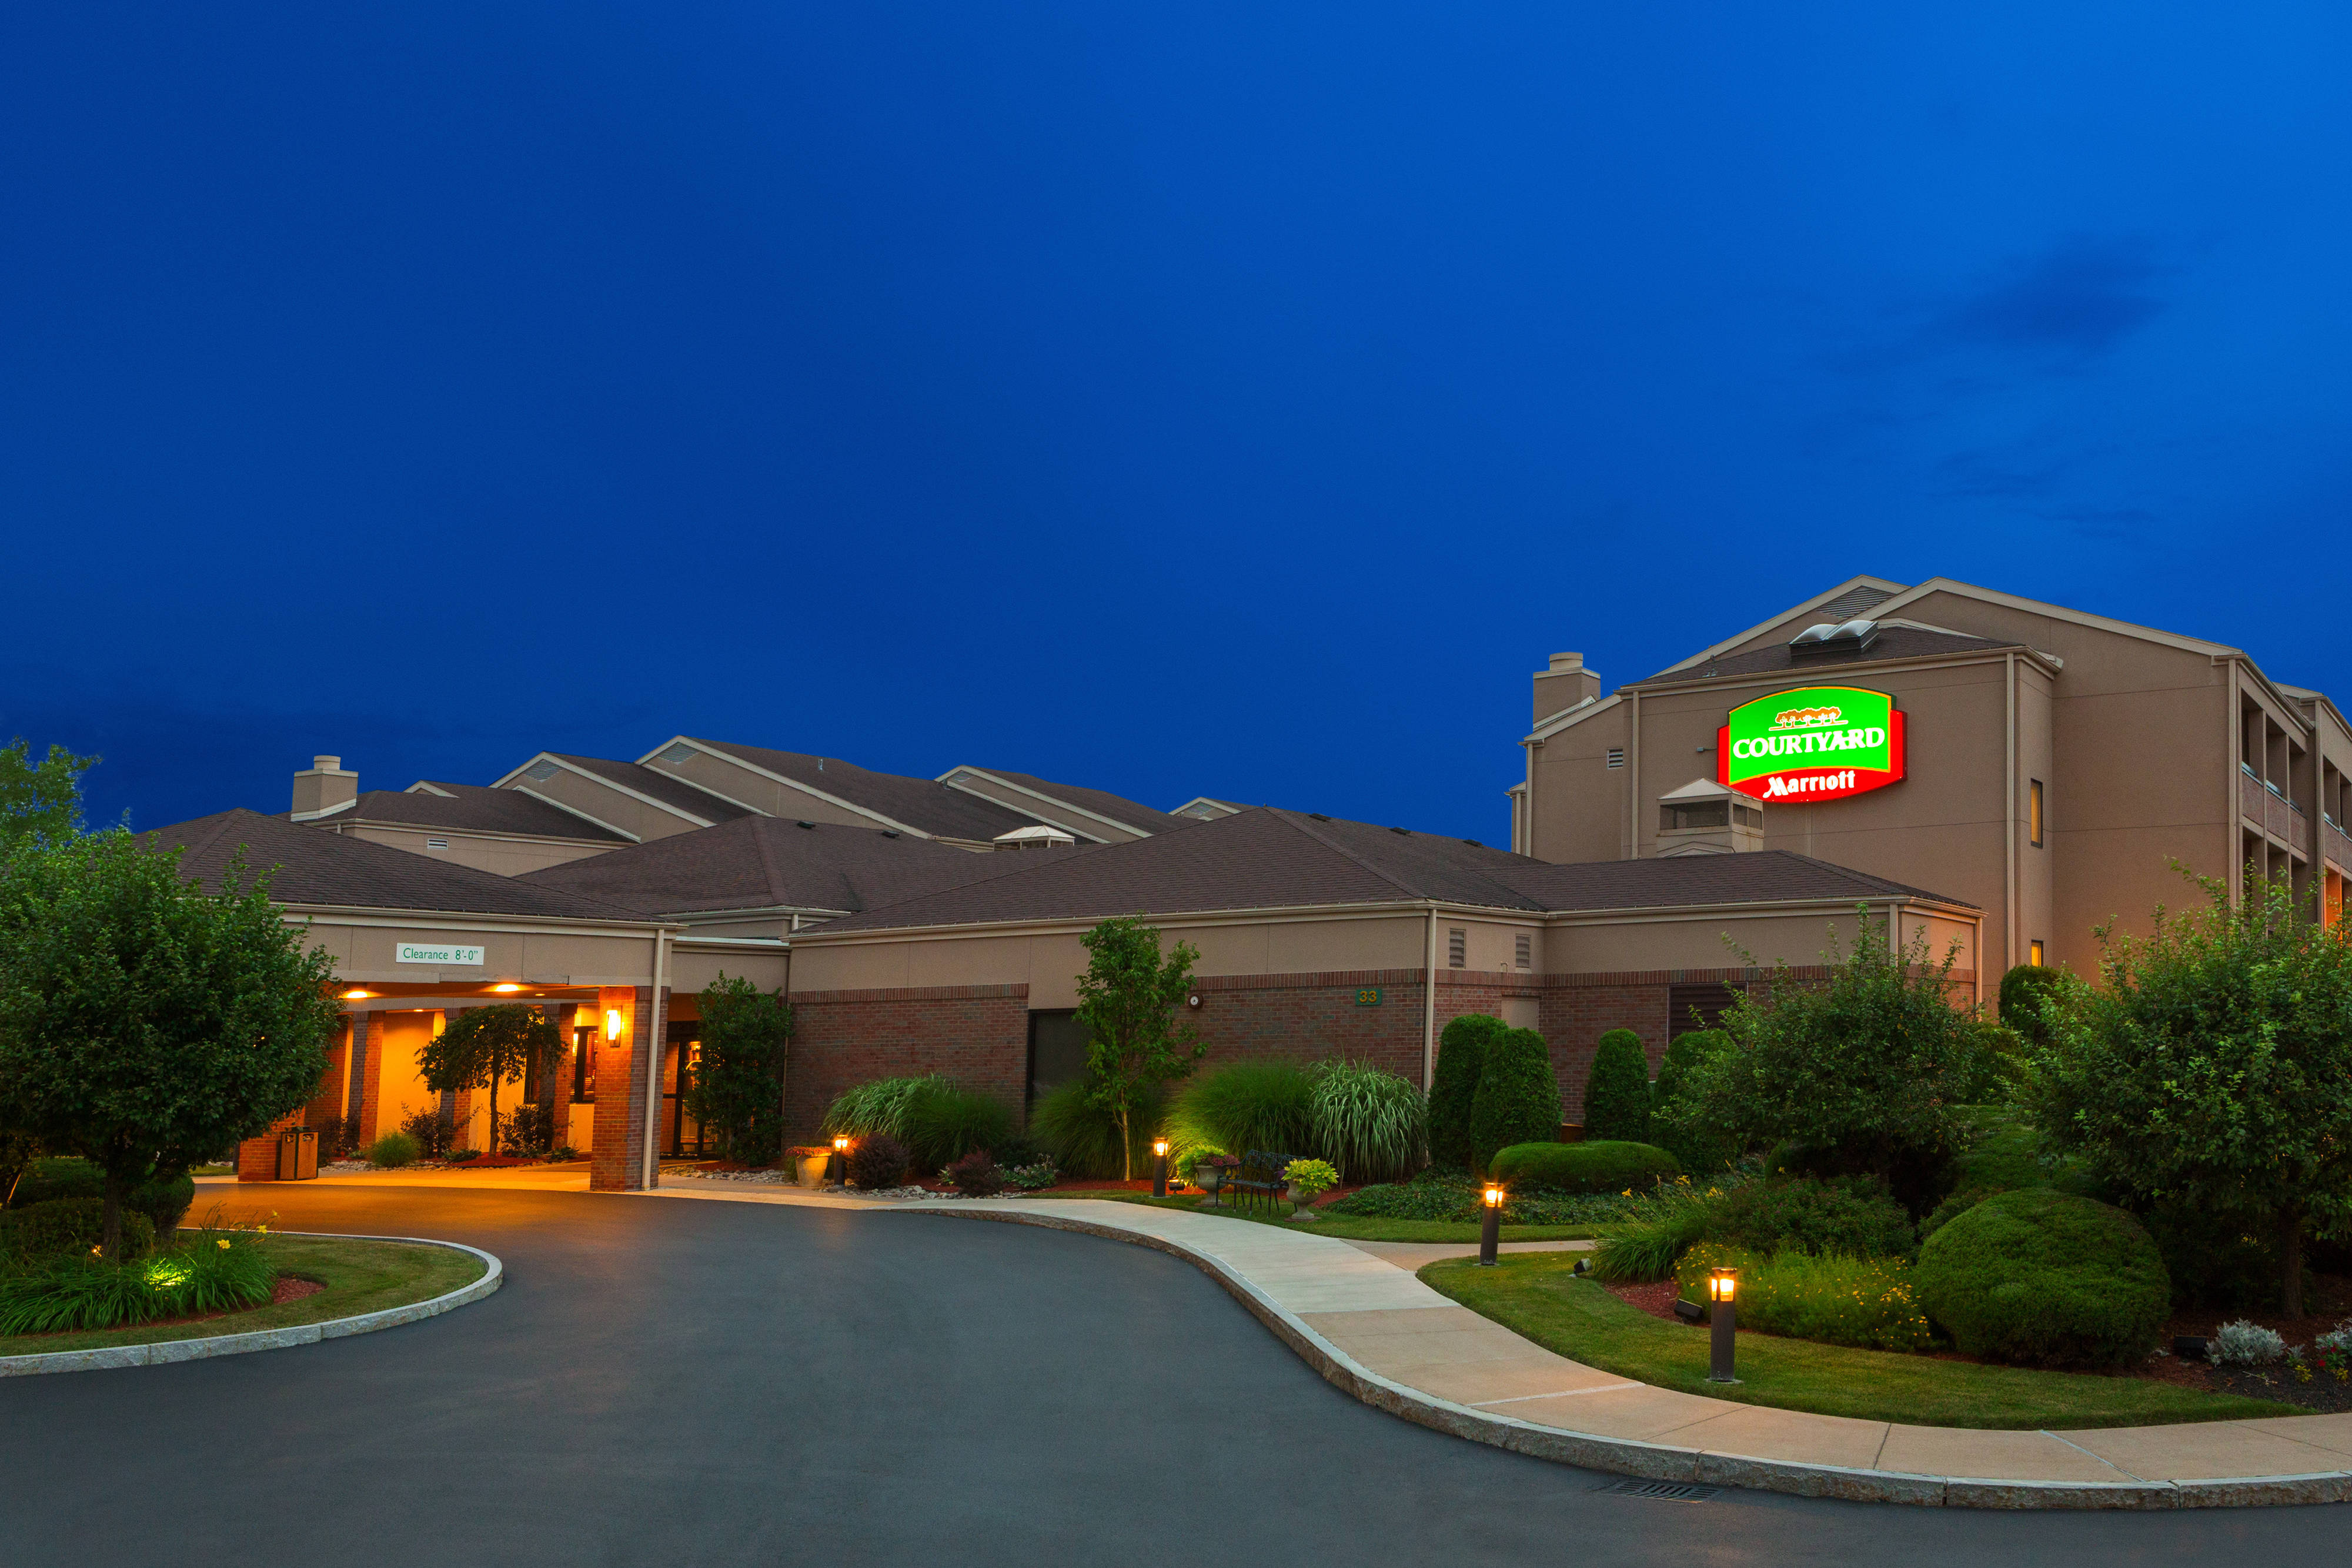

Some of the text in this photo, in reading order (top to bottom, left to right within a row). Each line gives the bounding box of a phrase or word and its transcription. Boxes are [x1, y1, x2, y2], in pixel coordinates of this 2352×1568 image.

[1733, 727, 1885, 758] COURTYARD
[1762, 770, 1856, 798] Marriott
[403, 947, 449, 959] Clearance
[1359, 991, 1377, 1002] 33
